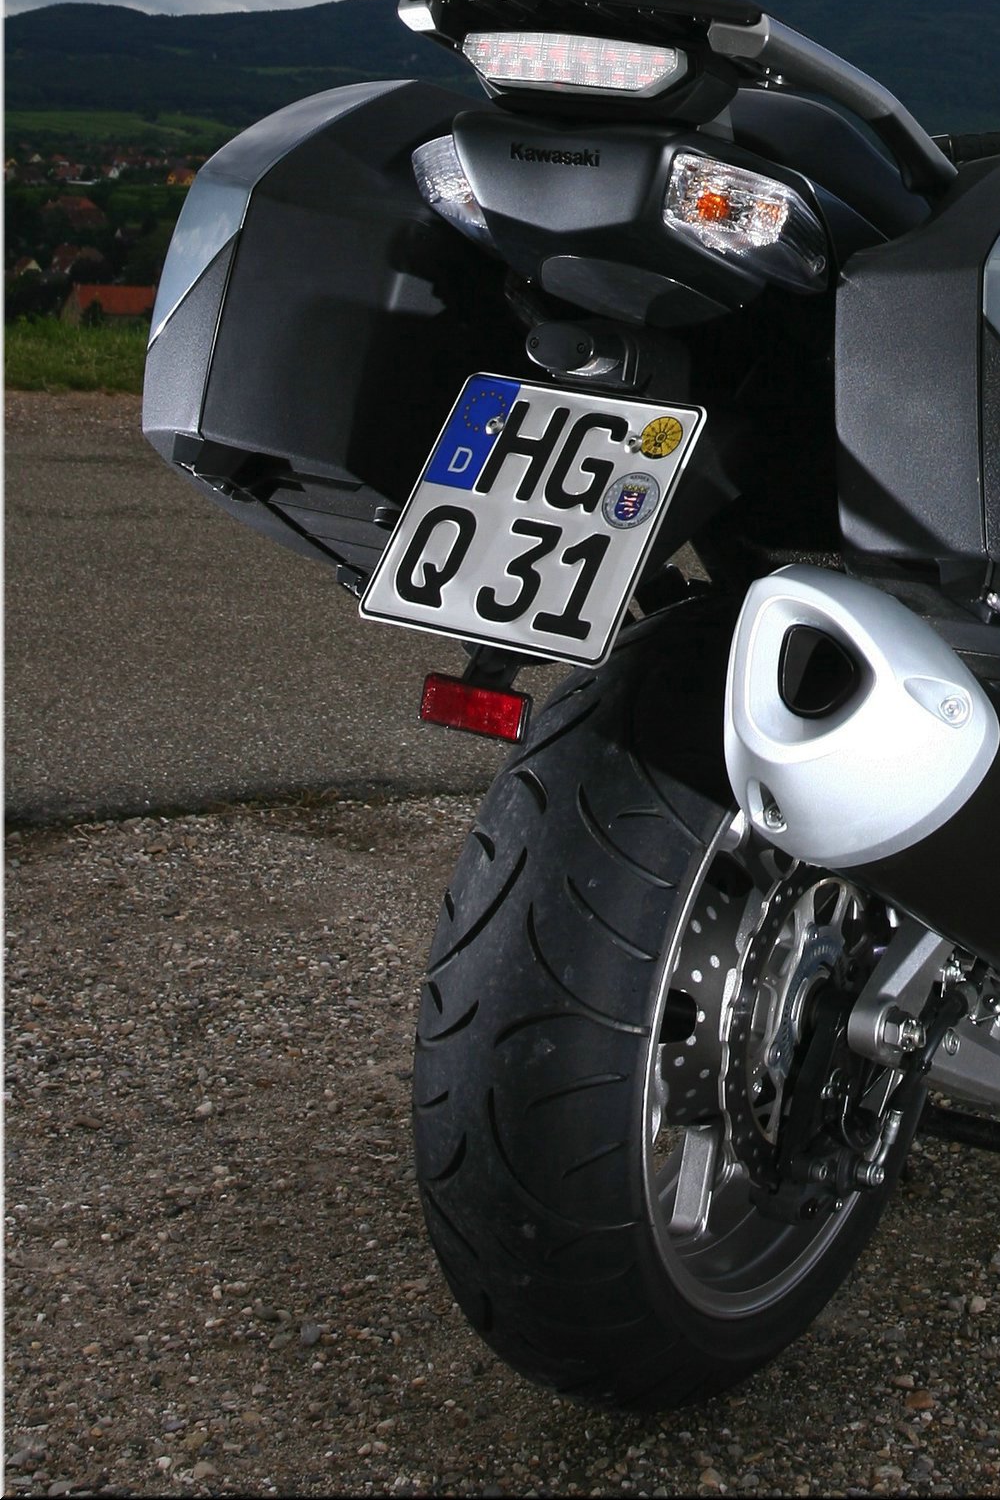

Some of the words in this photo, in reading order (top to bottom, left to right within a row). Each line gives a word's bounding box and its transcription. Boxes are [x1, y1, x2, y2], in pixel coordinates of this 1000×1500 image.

[511, 142, 600, 167] Kawasaki
[447, 446, 473, 473] D
[475, 400, 629, 513] HG
[395, 505, 477, 608] Q
[476, 519, 611, 639] 31
